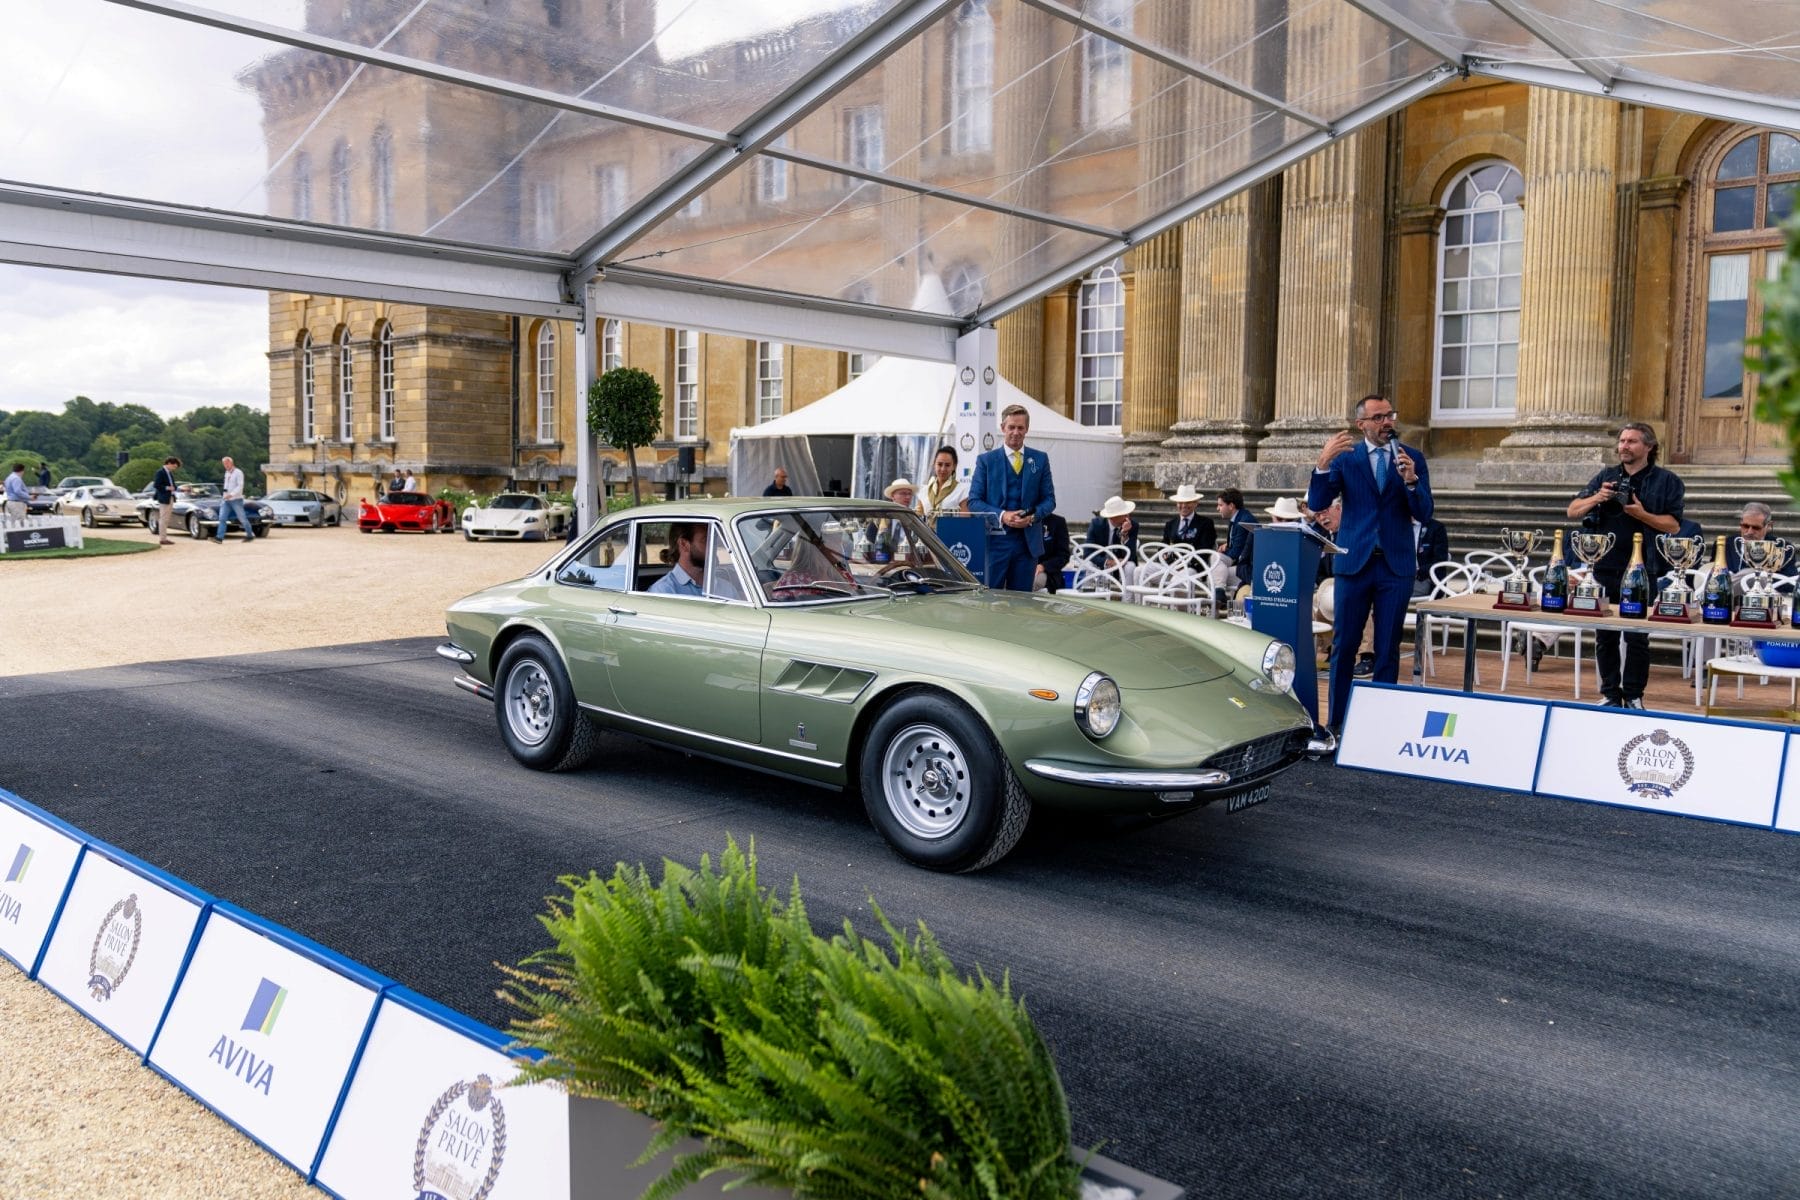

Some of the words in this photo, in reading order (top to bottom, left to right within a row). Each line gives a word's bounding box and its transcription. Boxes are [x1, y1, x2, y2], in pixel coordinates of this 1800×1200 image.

[1398, 742, 1470, 764] AVIVA
[1638, 747, 1677, 759] SALON
[1230, 793, 1247, 811] VAM
[110, 919, 133, 943] SALON
[208, 1034, 274, 1096] AVIVA
[444, 1108, 490, 1147] SALON
